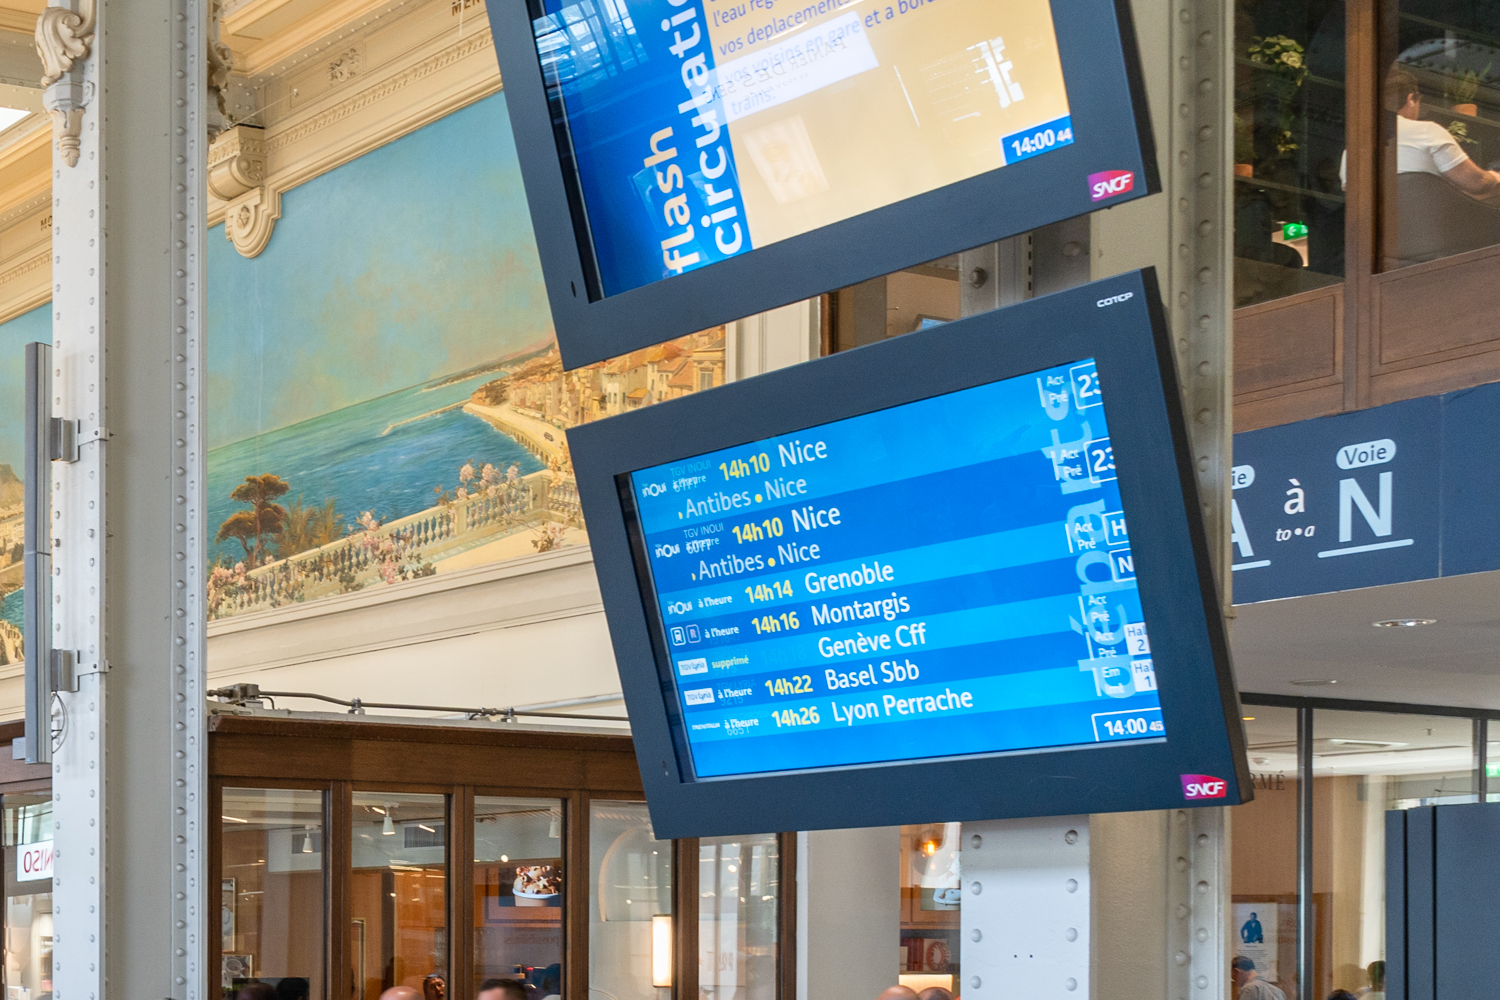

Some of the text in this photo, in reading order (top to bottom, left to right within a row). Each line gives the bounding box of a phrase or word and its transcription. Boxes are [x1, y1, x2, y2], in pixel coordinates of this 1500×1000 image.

[713, 4, 746, 27] l'eau
[719, 37, 744, 56] vos
[725, 66, 750, 85] vos
[754, 45, 802, 75] voisins
[806, 35, 824, 53] en
[827, 19, 861, 49] gare
[865, 10, 881, 28] et
[885, 6, 895, 20] a
[731, 91, 777, 116] trains.
[660, 0, 743, 256] circulati
[1011, 127, 1073, 157] 14:00 44
[643, 126, 701, 274] flash
[1092, 173, 1132, 198] SNCF
[719, 453, 770, 481] 14h10
[778, 440, 828, 467] Nice
[1344, 445, 1388, 466] Voie
[686, 477, 808, 518] Antibes Nice
[1232, 470, 1248, 487] ie
[732, 517, 783, 544] 14h10
[791, 506, 841, 533] Nice
[1283, 478, 1306, 515] à
[1339, 471, 1393, 543] N
[683, 522, 724, 539] TGV INOUI
[699, 542, 821, 581] Antibes Nice
[704, 595, 732, 607] l'heure
[745, 580, 793, 604] 14h14
[805, 561, 895, 594] Grenoble
[711, 626, 739, 638] l'heure
[751, 611, 800, 635] 14h16
[811, 592, 910, 626] Montargis
[711, 655, 750, 670] supprimé
[818, 631, 891, 658] Genève
[895, 622, 927, 648] Cff
[1136, 638, 1146, 651] 2
[724, 687, 752, 699] l'heure
[765, 675, 813, 697] 14h22
[825, 664, 878, 690] Basel
[880, 659, 920, 684] Sbb
[730, 718, 759, 729] l'heure
[771, 706, 820, 728] 14h26
[831, 701, 879, 727] Lyon
[883, 687, 974, 717] Perrache
[1104, 717, 1165, 737] 14:00 45
[1185, 781, 1225, 797] SNCF
